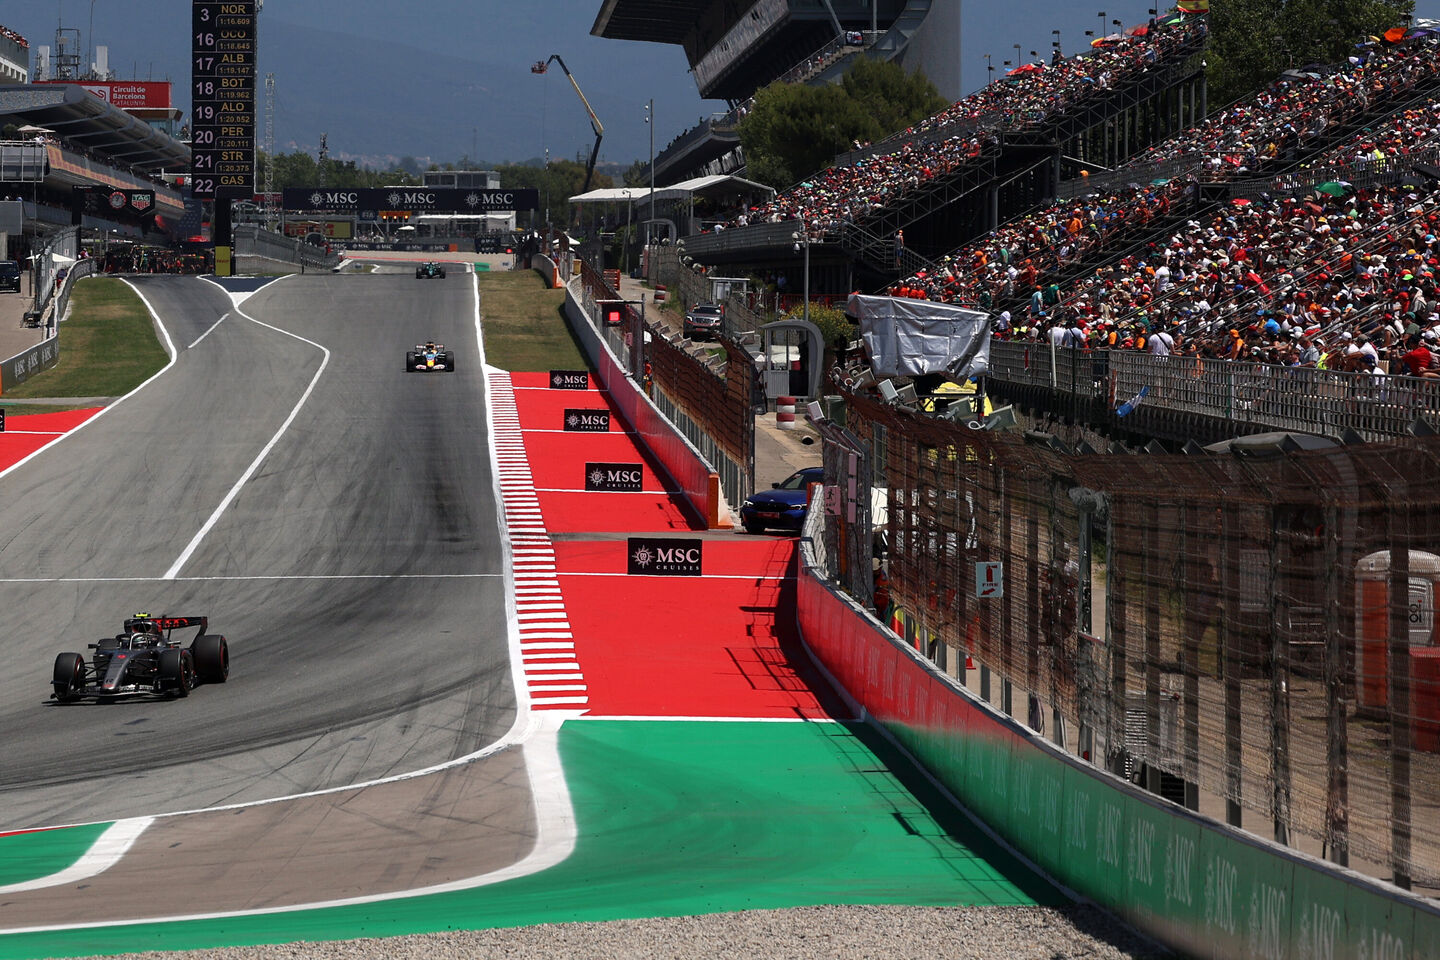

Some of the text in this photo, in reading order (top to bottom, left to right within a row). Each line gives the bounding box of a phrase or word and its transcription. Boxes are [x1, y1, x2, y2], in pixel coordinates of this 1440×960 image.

[201, 5, 246, 21] 3 NOR
[196, 31, 246, 46] 16 OCO
[196, 54, 244, 70] 17 ALB
[196, 78, 245, 95] 18 BOT
[196, 103, 245, 119] 19 ALO
[195, 127, 244, 144] 20 PER
[195, 151, 244, 168] 21 STR
[195, 176, 244, 192] 22 GAS
[326, 192, 358, 204] MSC
[404, 193, 436, 204] MSC
[482, 193, 514, 205] MSC
[564, 375, 587, 384] MSC
[581, 415, 608, 425] MSC
[607, 470, 641, 483] MSC
[656, 548, 700, 564] MSC
[1136, 818, 1156, 887] MSC
[1173, 834, 1195, 907] MSC
[1216, 856, 1238, 936] MSC
[1261, 883, 1286, 960] MSC
